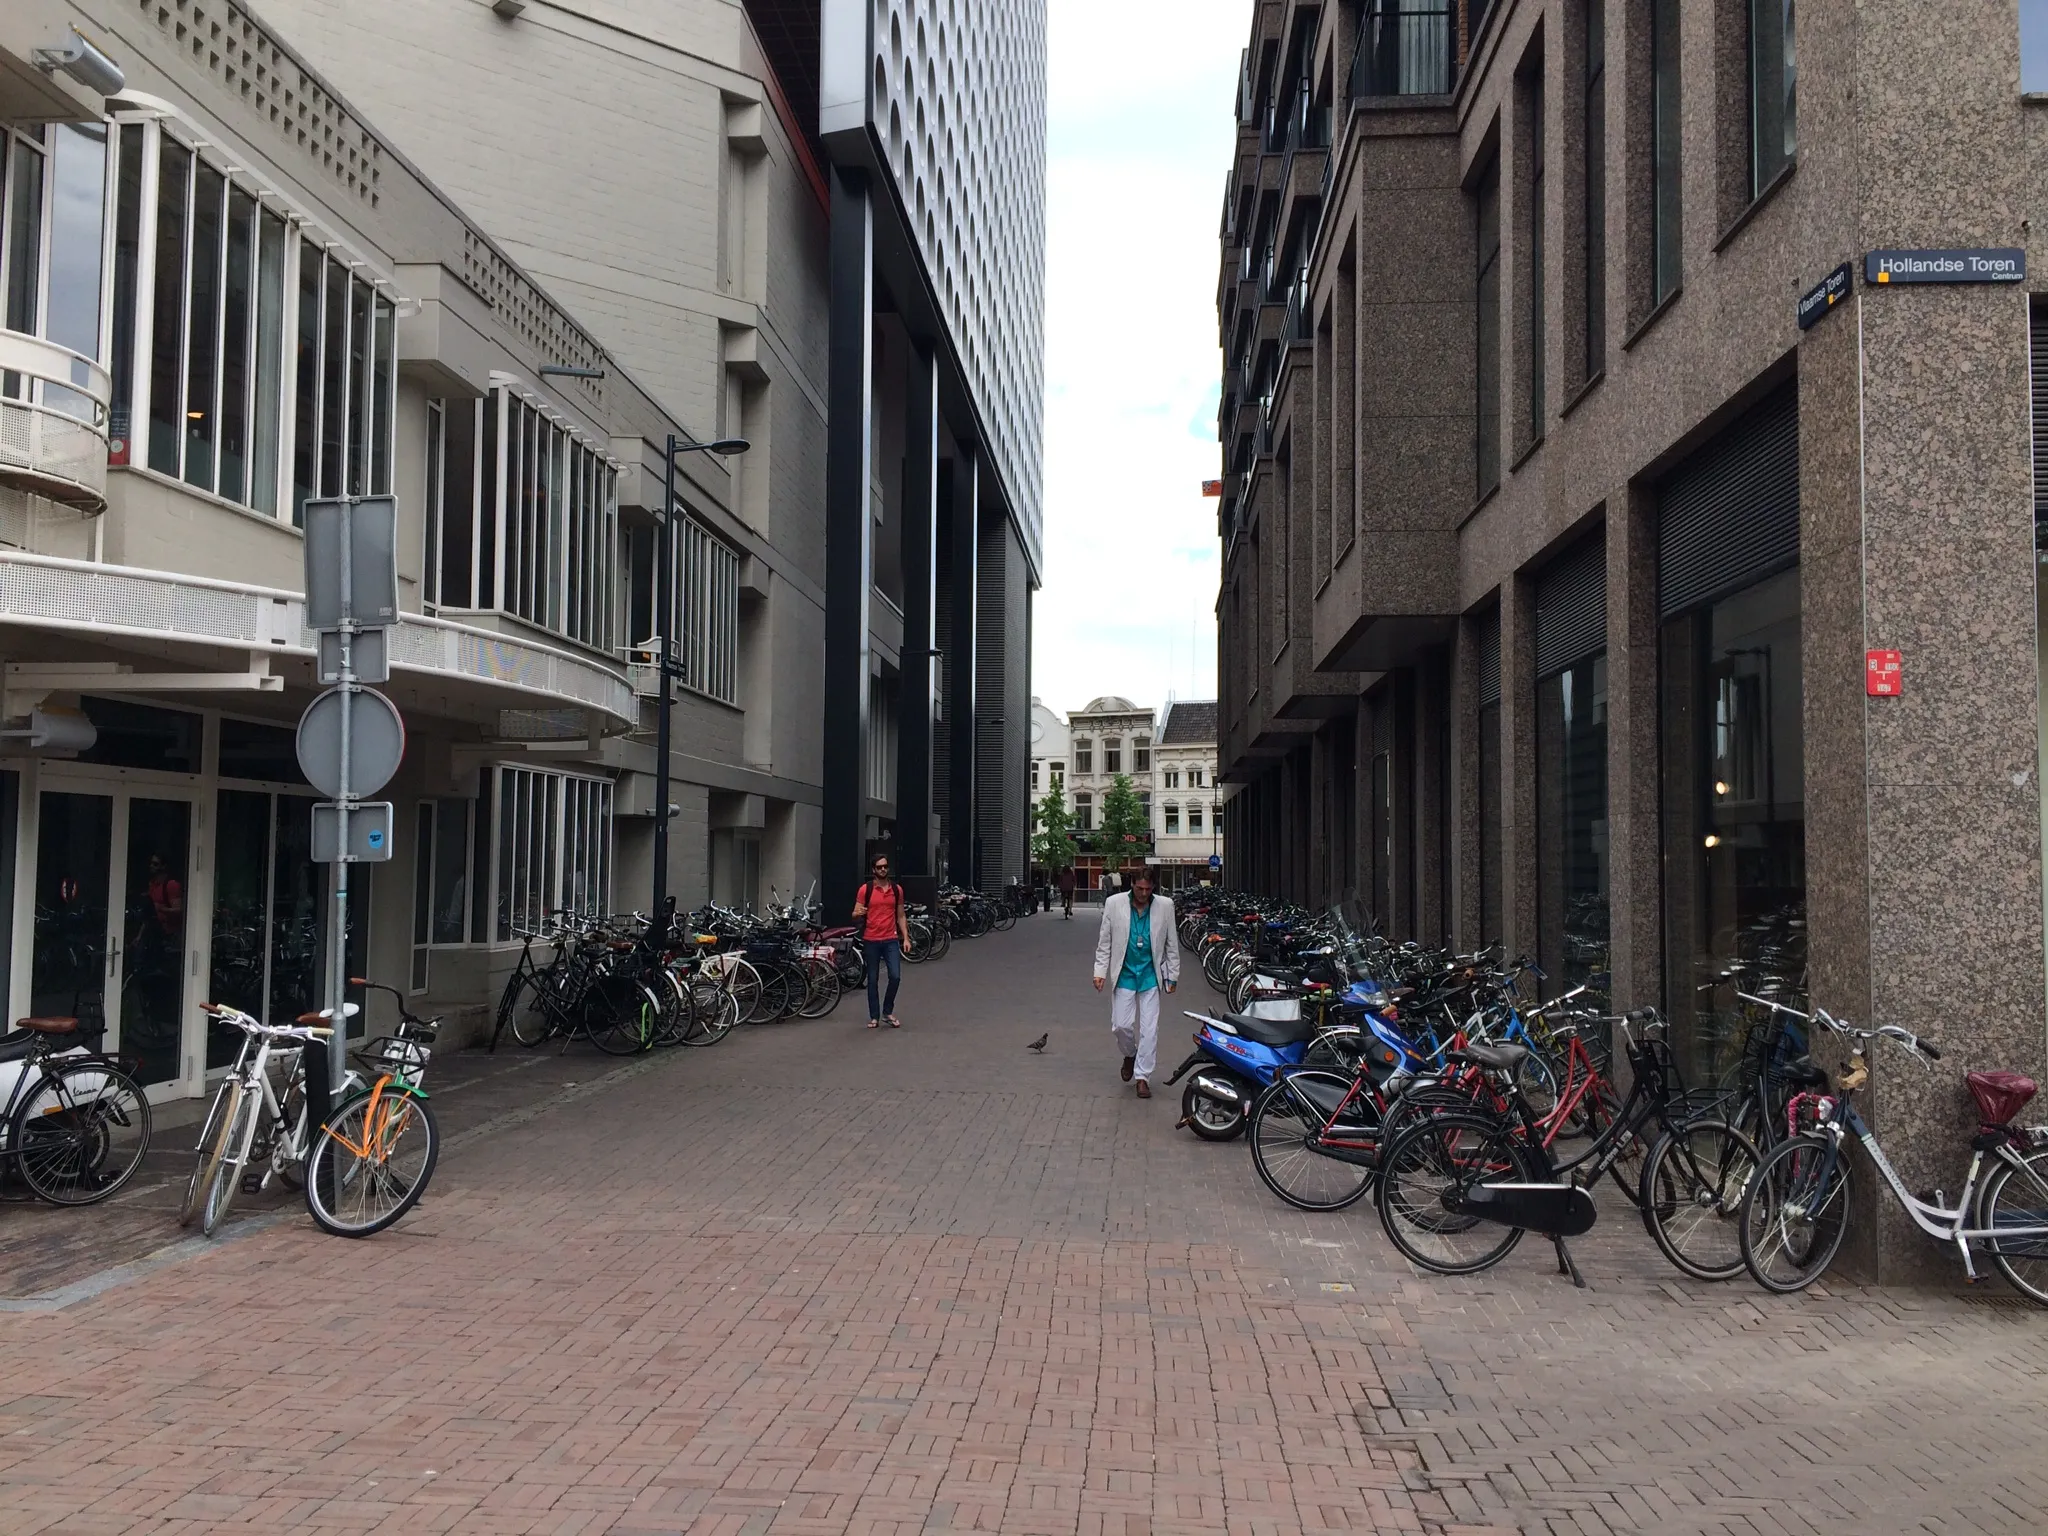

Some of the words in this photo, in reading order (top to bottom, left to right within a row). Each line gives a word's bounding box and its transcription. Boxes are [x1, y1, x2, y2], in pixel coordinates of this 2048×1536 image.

[1880, 258, 1965, 273] Hollandse
[1969, 257, 2015, 272] Toren
[1799, 287, 1826, 315] Vlaamse
[1826, 271, 1845, 293] Toren
